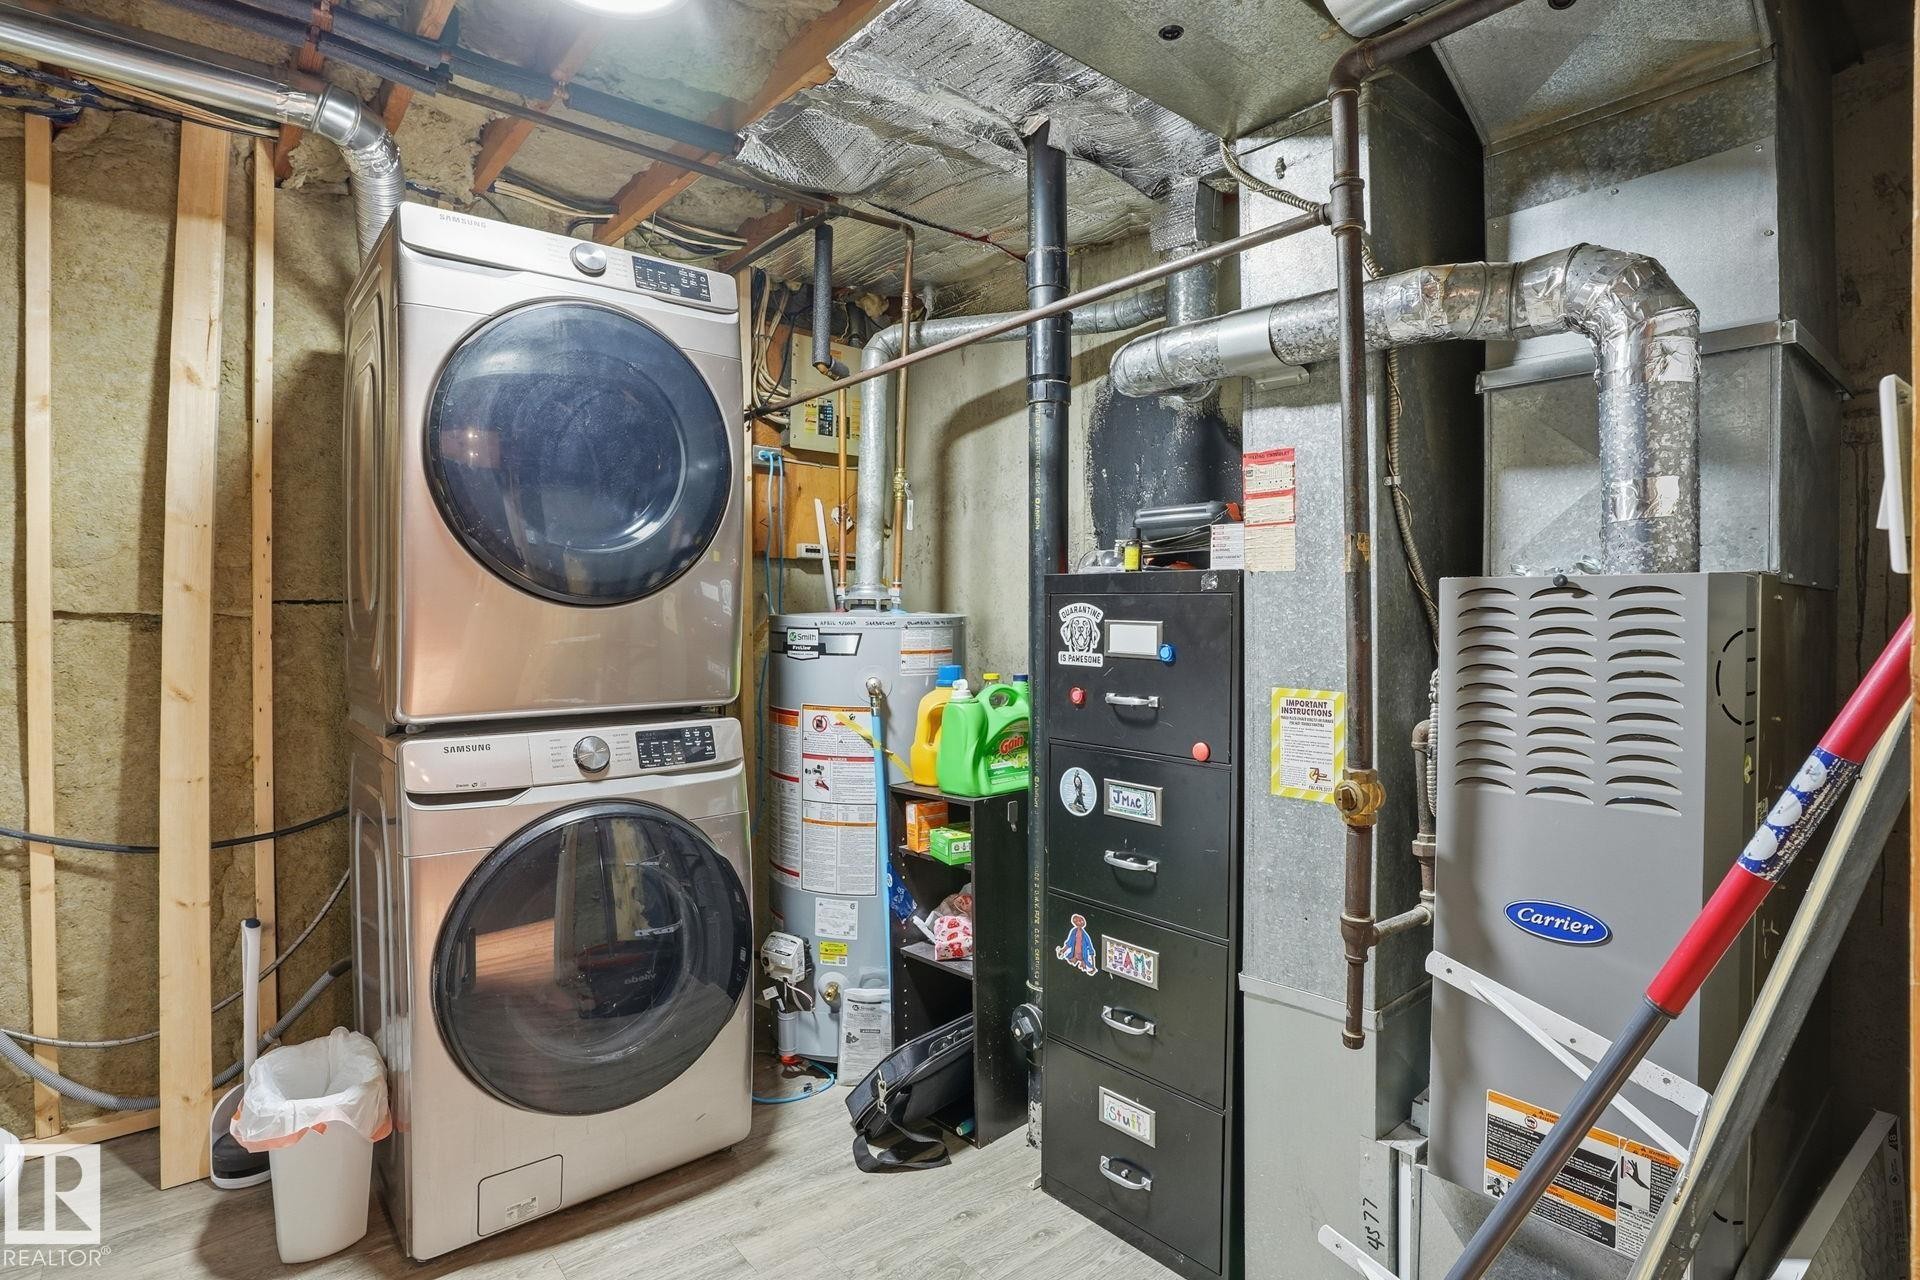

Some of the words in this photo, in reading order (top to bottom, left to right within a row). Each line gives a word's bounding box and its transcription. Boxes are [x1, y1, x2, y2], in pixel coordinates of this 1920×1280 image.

[439, 213, 486, 229] SAMSUNG
[1061, 605, 1102, 620] QUARANTINE
[797, 632, 817, 641] Smith
[1060, 654, 1067, 662] IS
[1068, 654, 1102, 664] PAWESOME
[1286, 699, 1328, 709] IMPORTANT
[1281, 707, 1333, 718] INSTRUCTIONS
[443, 743, 491, 755] SAMSUNG
[1000, 735, 1024, 754] Gain
[1517, 907, 1594, 934] Carrier
[1109, 1106, 1142, 1132] Stuff
